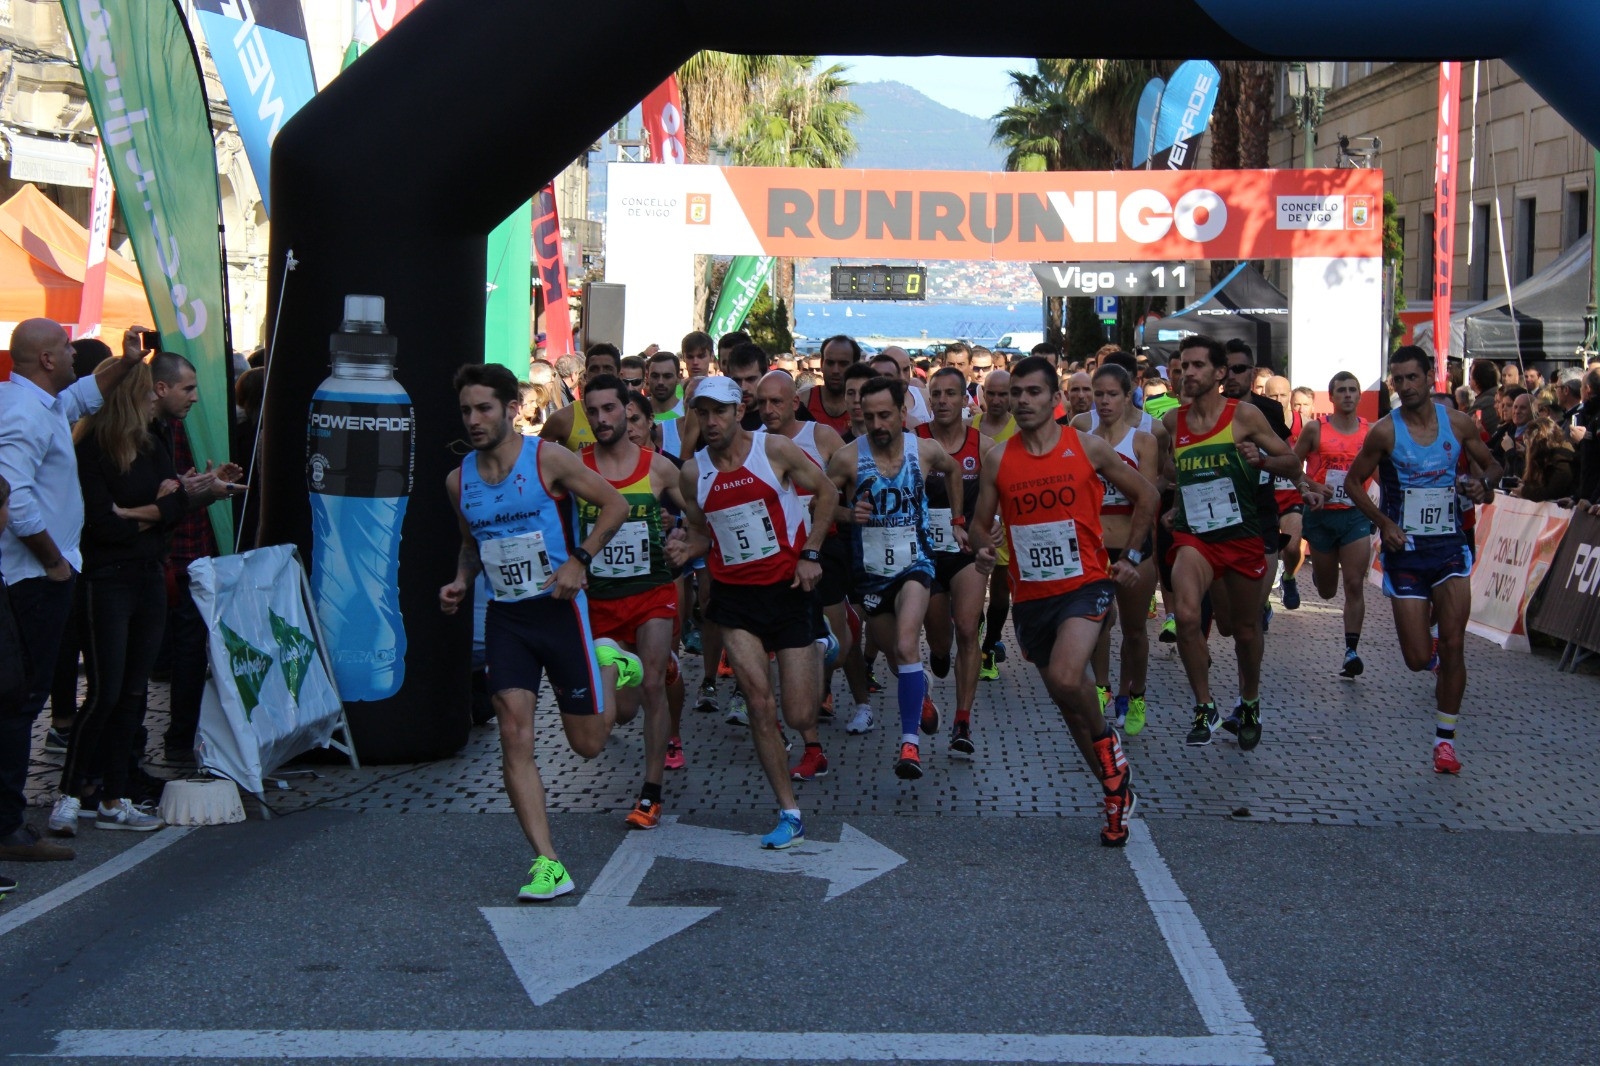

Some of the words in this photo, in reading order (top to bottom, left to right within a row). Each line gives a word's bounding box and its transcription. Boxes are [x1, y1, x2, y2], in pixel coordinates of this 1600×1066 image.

[1167, 73, 1214, 170] ERADE
[621, 197, 677, 207] CONCELLO
[1281, 202, 1338, 213] CONCELLO
[628, 208, 641, 217] DE
[645, 208, 670, 218] VIGO
[1288, 213, 1302, 223] DE
[1305, 213, 1332, 223] VIGO
[1052, 266, 1115, 293] Vigo
[1125, 273, 1138, 288] +
[1151, 266, 1186, 288] 11
[1102, 296, 1116, 312] P
[311, 414, 411, 431] POWERADE
[1180, 453, 1230, 471] BIKILA
[714, 484, 721, 492] O
[723, 477, 754, 490] BARCO
[1013, 486, 1076, 516] 1900
[1207, 502, 1215, 519] 1
[1420, 508, 1442, 525] 167
[736, 529, 750, 550] 5
[604, 545, 635, 565] 925
[885, 548, 895, 566] 8
[1029, 546, 1065, 568] 936
[499, 560, 532, 587] 597
